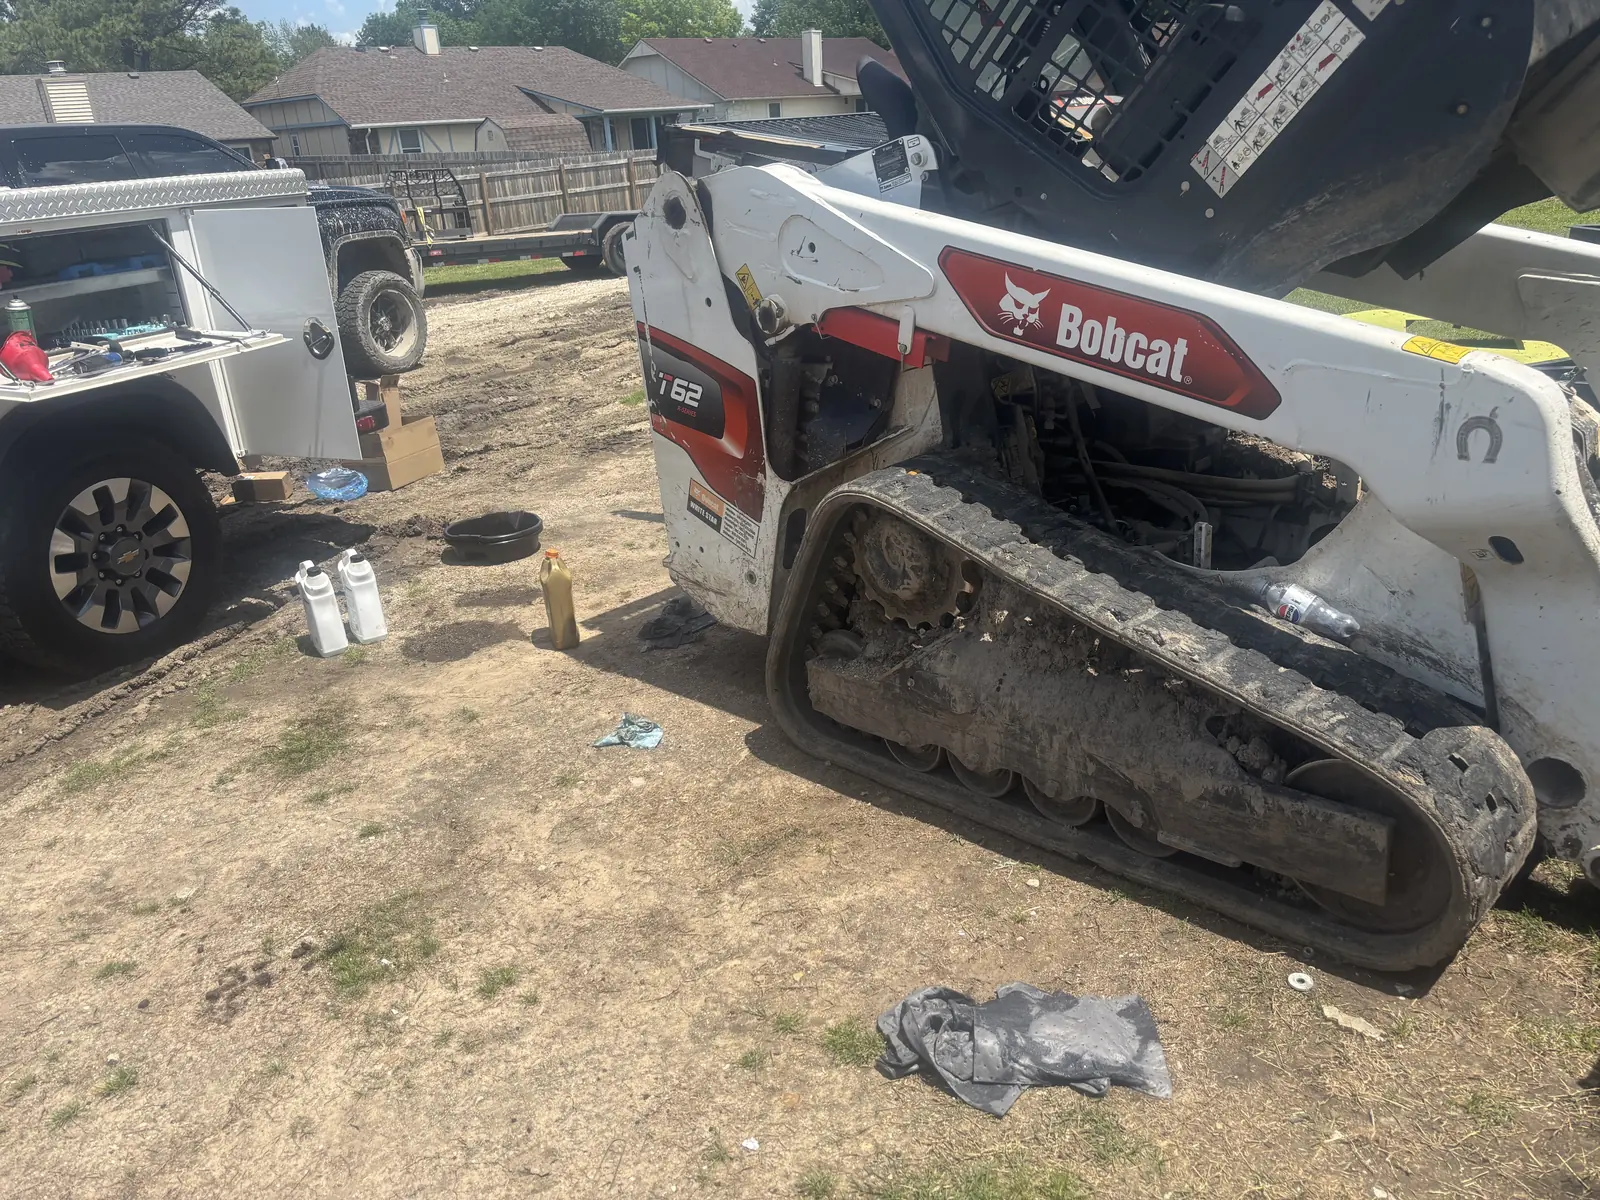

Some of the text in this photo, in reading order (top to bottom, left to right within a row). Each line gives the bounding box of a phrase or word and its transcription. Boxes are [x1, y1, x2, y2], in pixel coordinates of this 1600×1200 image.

[1056, 302, 1188, 384] Bobcat
[659, 371, 703, 408] T62
[690, 500, 718, 525] WHITE STAR
